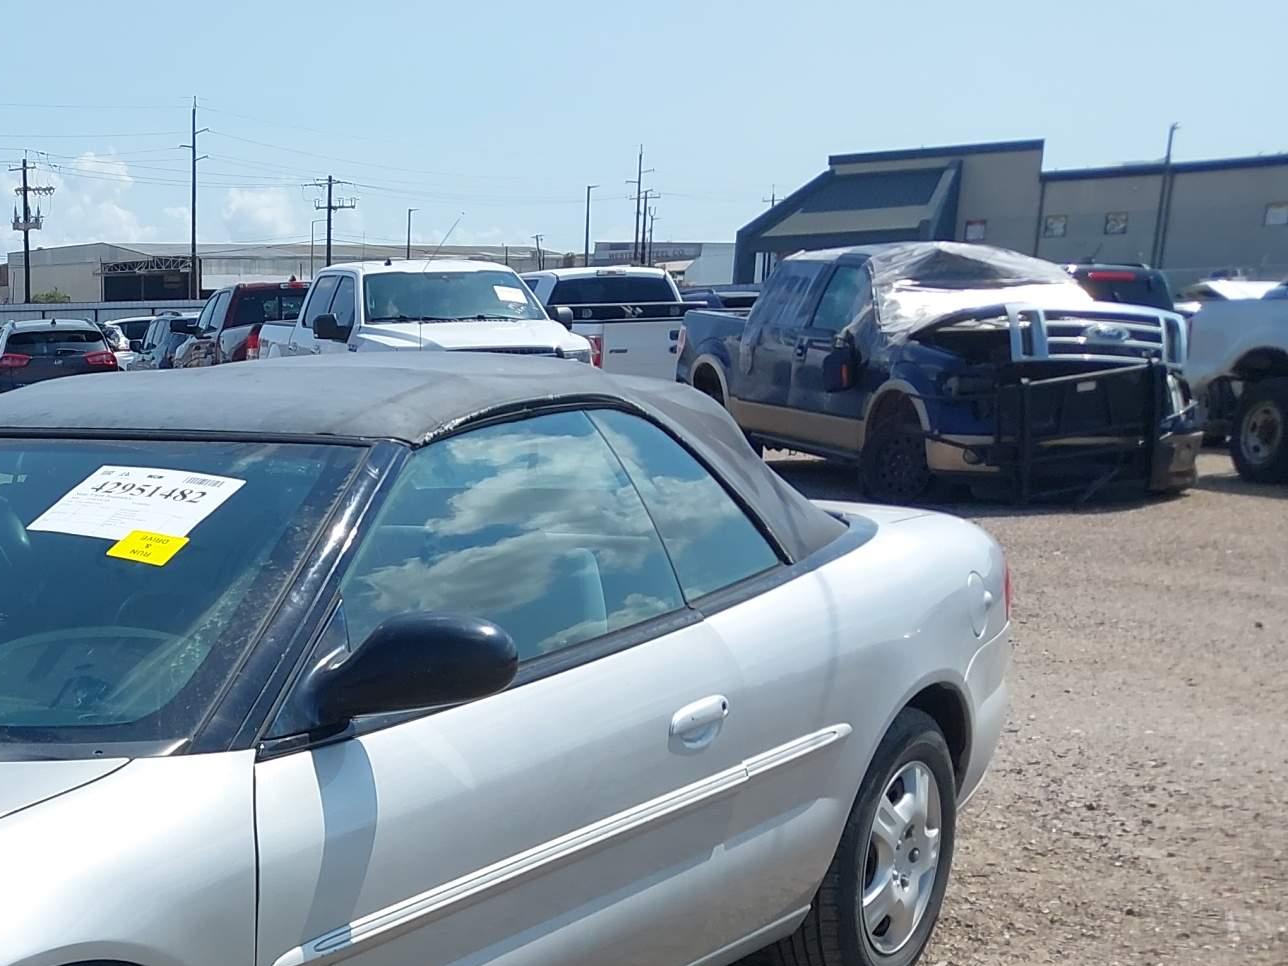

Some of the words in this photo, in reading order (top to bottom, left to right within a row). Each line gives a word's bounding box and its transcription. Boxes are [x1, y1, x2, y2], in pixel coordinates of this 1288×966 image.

[91, 480, 208, 504] 42951482
[140, 535, 171, 545] DRIVE
[130, 549, 152, 557] RUN
